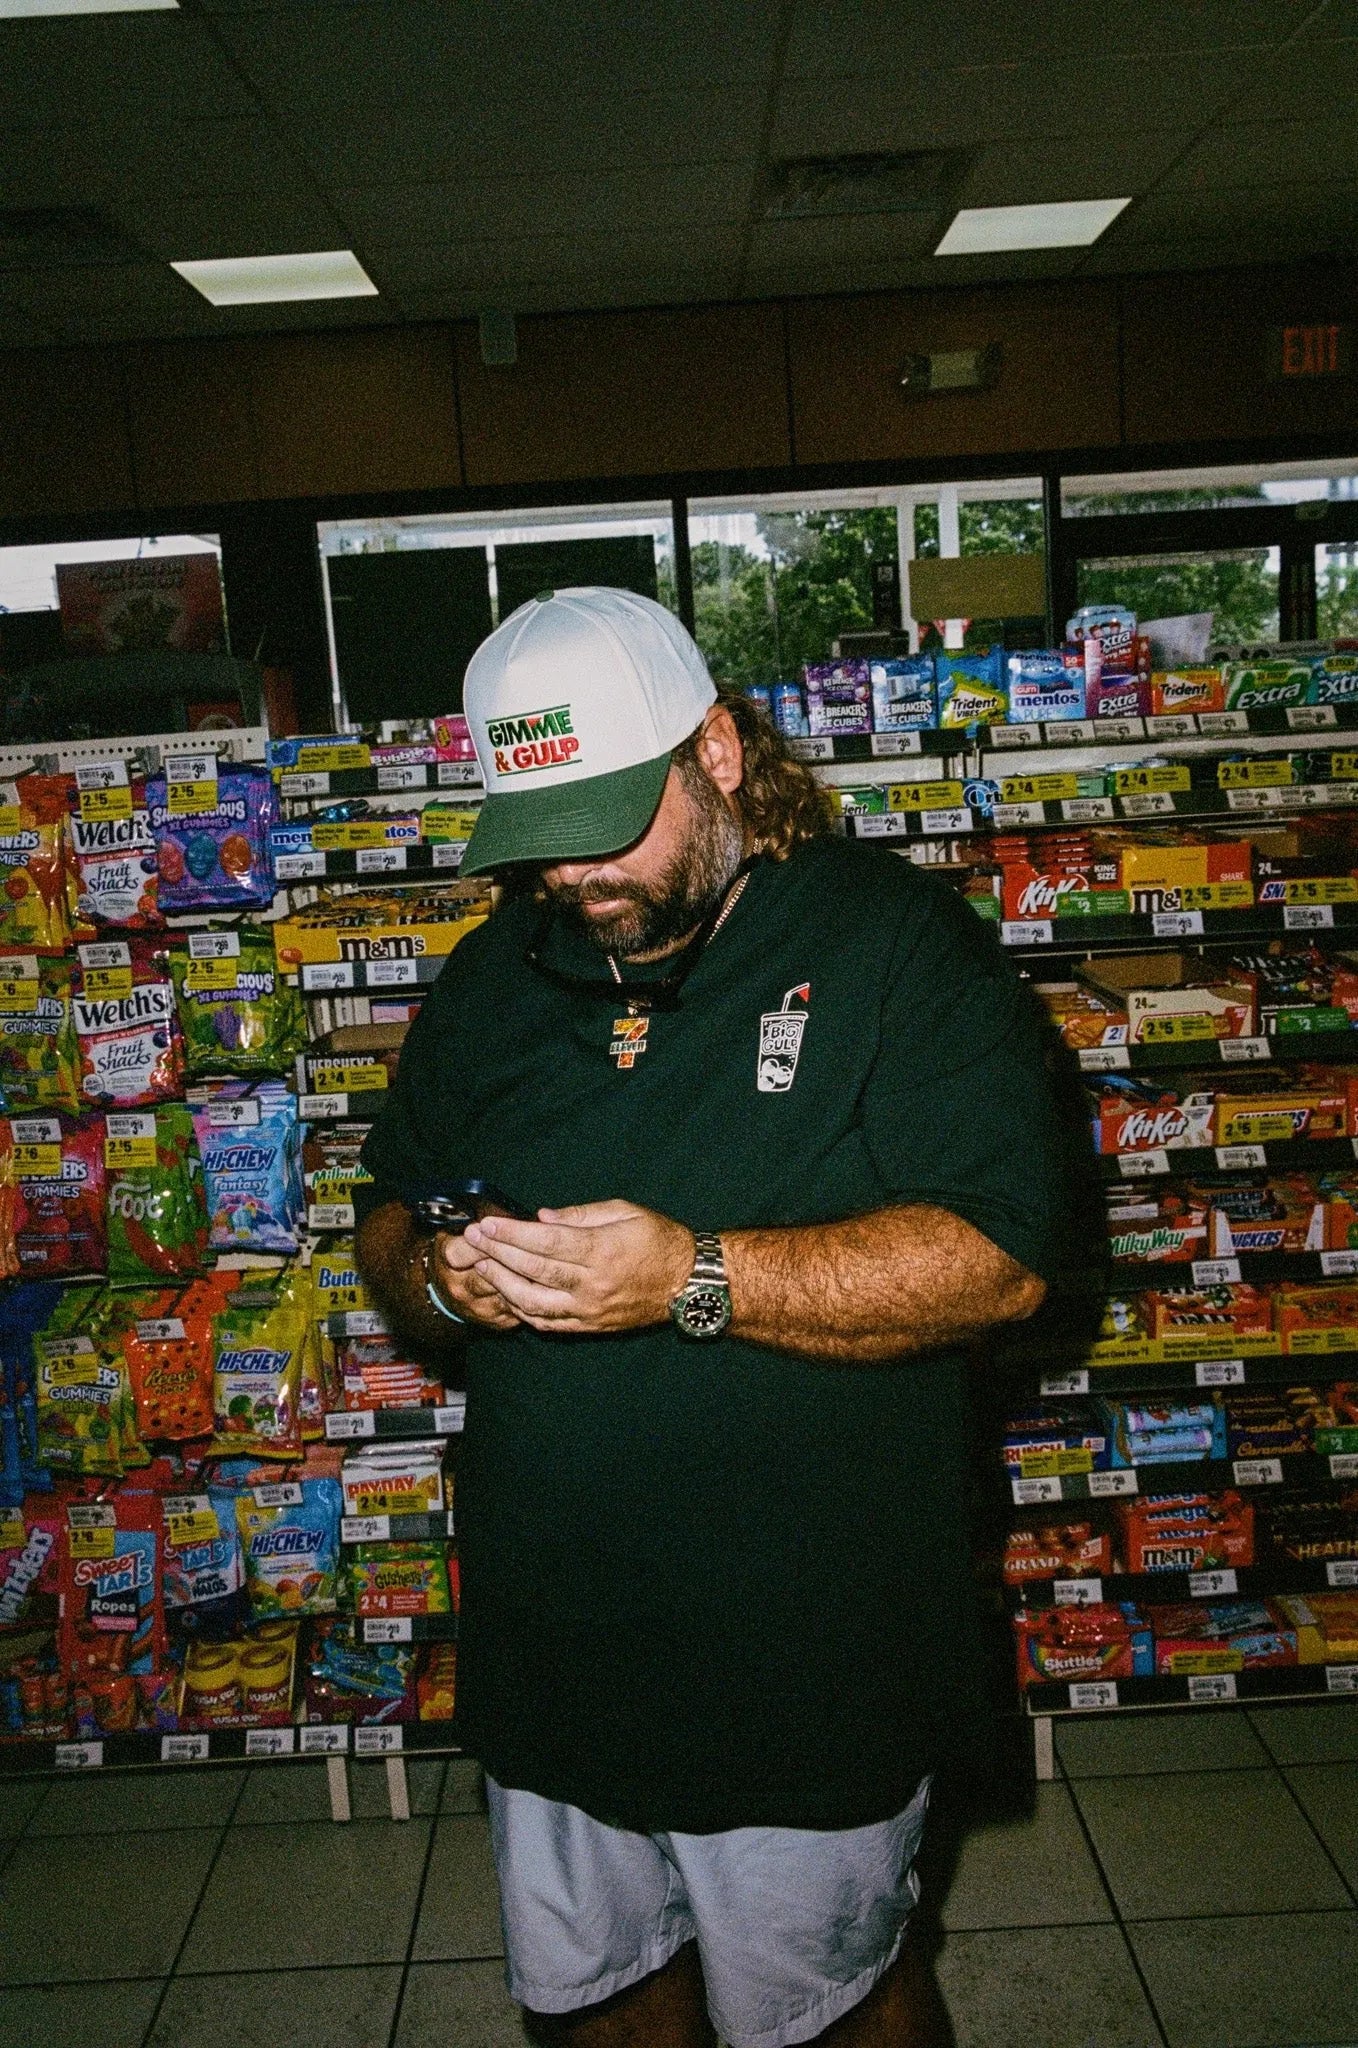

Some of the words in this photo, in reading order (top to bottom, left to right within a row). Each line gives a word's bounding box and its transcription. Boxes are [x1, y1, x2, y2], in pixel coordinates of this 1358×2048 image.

[1160, 682, 1206, 696] Trident
[1237, 682, 1301, 709] Extra
[952, 697, 998, 710] Trident
[1015, 693, 1080, 706] mentos
[1098, 693, 1138, 715] Extra
[827, 703, 868, 717] BREAKERS
[891, 700, 933, 715] BREAKERS
[957, 710, 980, 718] VIBES
[833, 716, 864, 726] CUBES
[899, 713, 929, 724] CUBES
[488, 710, 575, 748] GIMME
[495, 751, 511, 773] &
[512, 736, 580, 769] GULP
[1120, 774, 1128, 786] 2
[1134, 772, 1148, 785] $4
[1222, 768, 1230, 780] 2
[170, 787, 178, 798] 2
[182, 785, 194, 797] $5
[1006, 783, 1014, 795] 2
[1019, 781, 1034, 794] $4
[83, 794, 91, 806] 2
[95, 792, 108, 805] $5
[892, 791, 901, 804] 2
[906, 789, 920, 802] $4
[75, 814, 154, 847] Welch's
[97, 863, 131, 882] Fruit
[1094, 864, 1116, 873] KING
[1220, 871, 1245, 881] SHARE
[1259, 862, 1272, 875] 24
[1097, 872, 1117, 881] SIZE
[88, 876, 140, 895] Snacks
[1289, 885, 1298, 897] 2
[1302, 883, 1317, 896] $5
[1184, 889, 1193, 902] 2
[1198, 887, 1212, 900] $5
[338, 936, 426, 962] m&m's
[190, 963, 197, 974] 2
[201, 962, 214, 973] $5
[86, 974, 94, 986] 2
[97, 973, 109, 984] $5
[78, 989, 165, 1028] Welch's
[1135, 997, 1147, 1009] 24
[1146, 1022, 1155, 1035] 2
[108, 1039, 144, 1059] Fruit
[612, 1017, 650, 1068] 7
[762, 1037, 798, 1053] GULP
[97, 1052, 152, 1074] Snacks
[318, 1073, 327, 1086] 2
[330, 1071, 345, 1084] $4
[1118, 1109, 1188, 1147] KitKat
[14, 1148, 22, 1160] 2
[26, 1147, 38, 1159] $6
[108, 1141, 116, 1153] 2
[119, 1140, 132, 1152] $5
[204, 1147, 277, 1173] HI-CHEW
[23, 1185, 80, 1199] GUMMIES
[213, 1176, 267, 1195] fantasy
[320, 1183, 329, 1197] 2
[332, 1182, 347, 1196] $4
[1150, 1227, 1185, 1253] Way
[330, 1291, 338, 1304] 2
[342, 1289, 357, 1303] $4
[51, 1360, 58, 1372] 2
[215, 1350, 291, 1374] HI-CHEW
[144, 1368, 198, 1388] Reese's
[49, 1386, 111, 1405] GUMMIES
[348, 1475, 416, 1499] PAYDAY
[361, 1497, 369, 1508] 2
[373, 1495, 387, 1507] $4
[172, 1518, 179, 1529] 2
[73, 1532, 79, 1543] 2
[250, 1530, 324, 1556] HI-CHEW
[1003, 1556, 1061, 1571] GRAND
[192, 1579, 228, 1597] HALOS
[374, 1571, 422, 1590] Gushers
[90, 1599, 137, 1614] Ropes
[361, 1595, 370, 1610] 2
[373, 1594, 388, 1610] $4
[1044, 1655, 1104, 1672] Skittles
